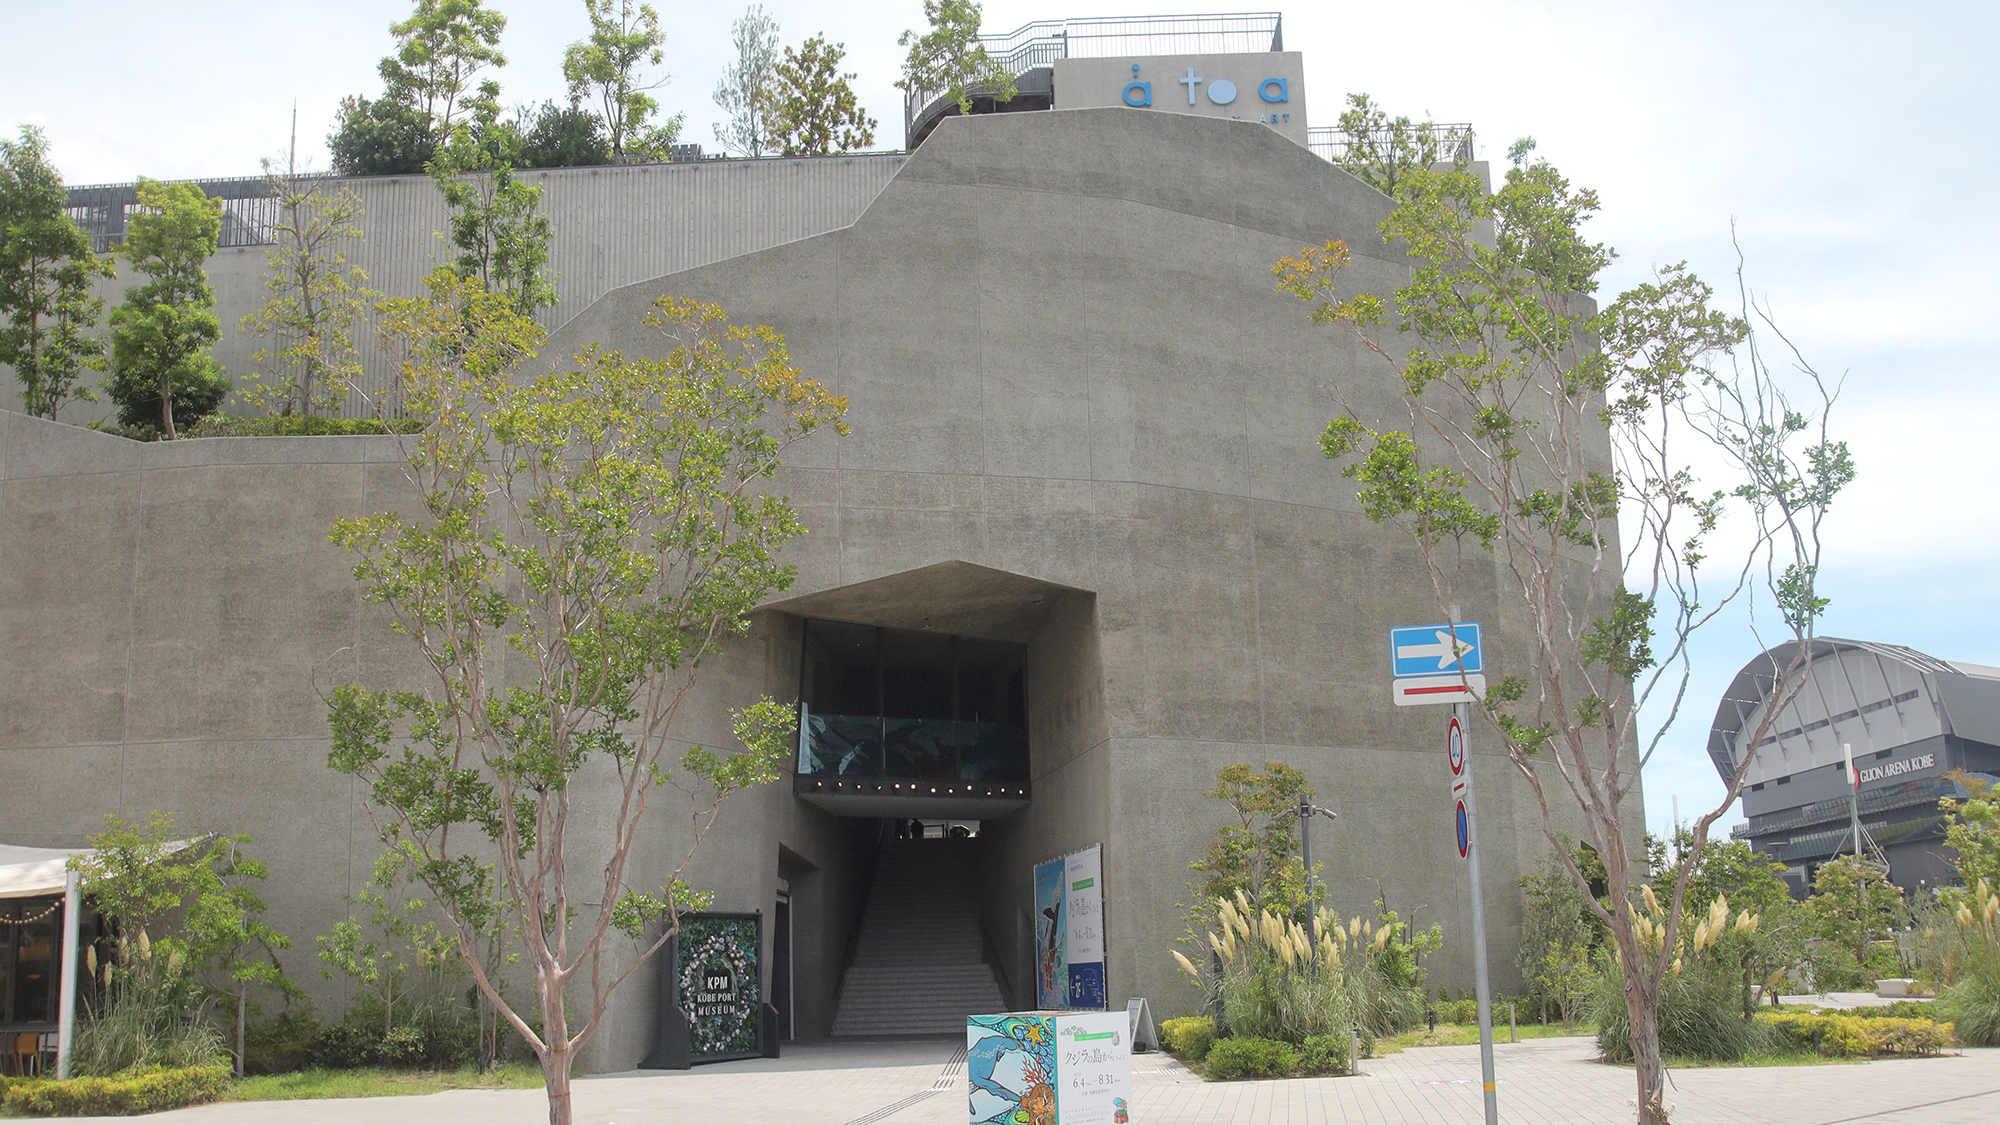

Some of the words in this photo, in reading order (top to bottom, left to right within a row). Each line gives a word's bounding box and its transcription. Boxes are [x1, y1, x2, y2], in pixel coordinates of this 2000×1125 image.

[1860, 765, 1884, 783] GLION
[1884, 759, 1910, 778] ARENA
[1910, 753, 1935, 771] KOBE
[707, 976, 728, 990] KPM
[697, 992, 716, 1003] KOBE
[717, 992, 736, 1002] PORT
[698, 1005, 736, 1016] MUSEUM
[1064, 1047, 1115, 1065] クジラの島から
